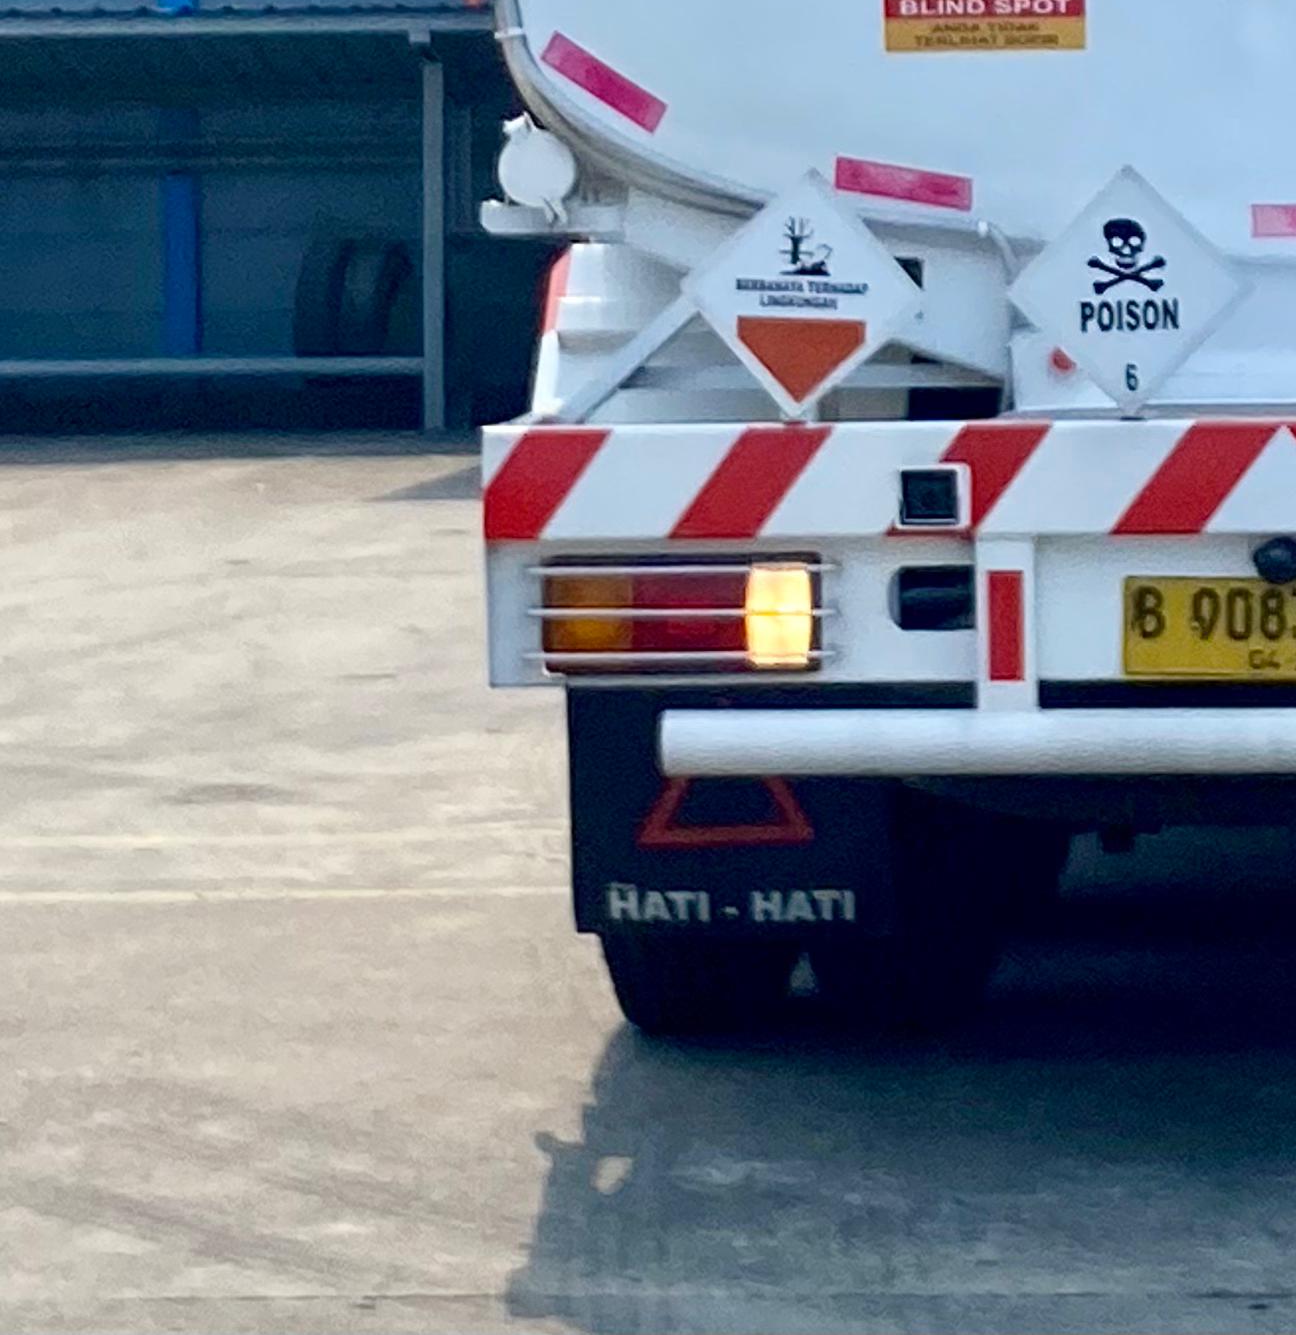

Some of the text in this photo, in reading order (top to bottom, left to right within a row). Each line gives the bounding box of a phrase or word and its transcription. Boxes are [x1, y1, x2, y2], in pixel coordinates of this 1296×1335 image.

[1080, 298, 1180, 333] POISON
[1125, 363, 1139, 391] 6
[1132, 586, 1165, 640] B
[609, 881, 710, 922] HATI
[750, 889, 855, 922] HATI
